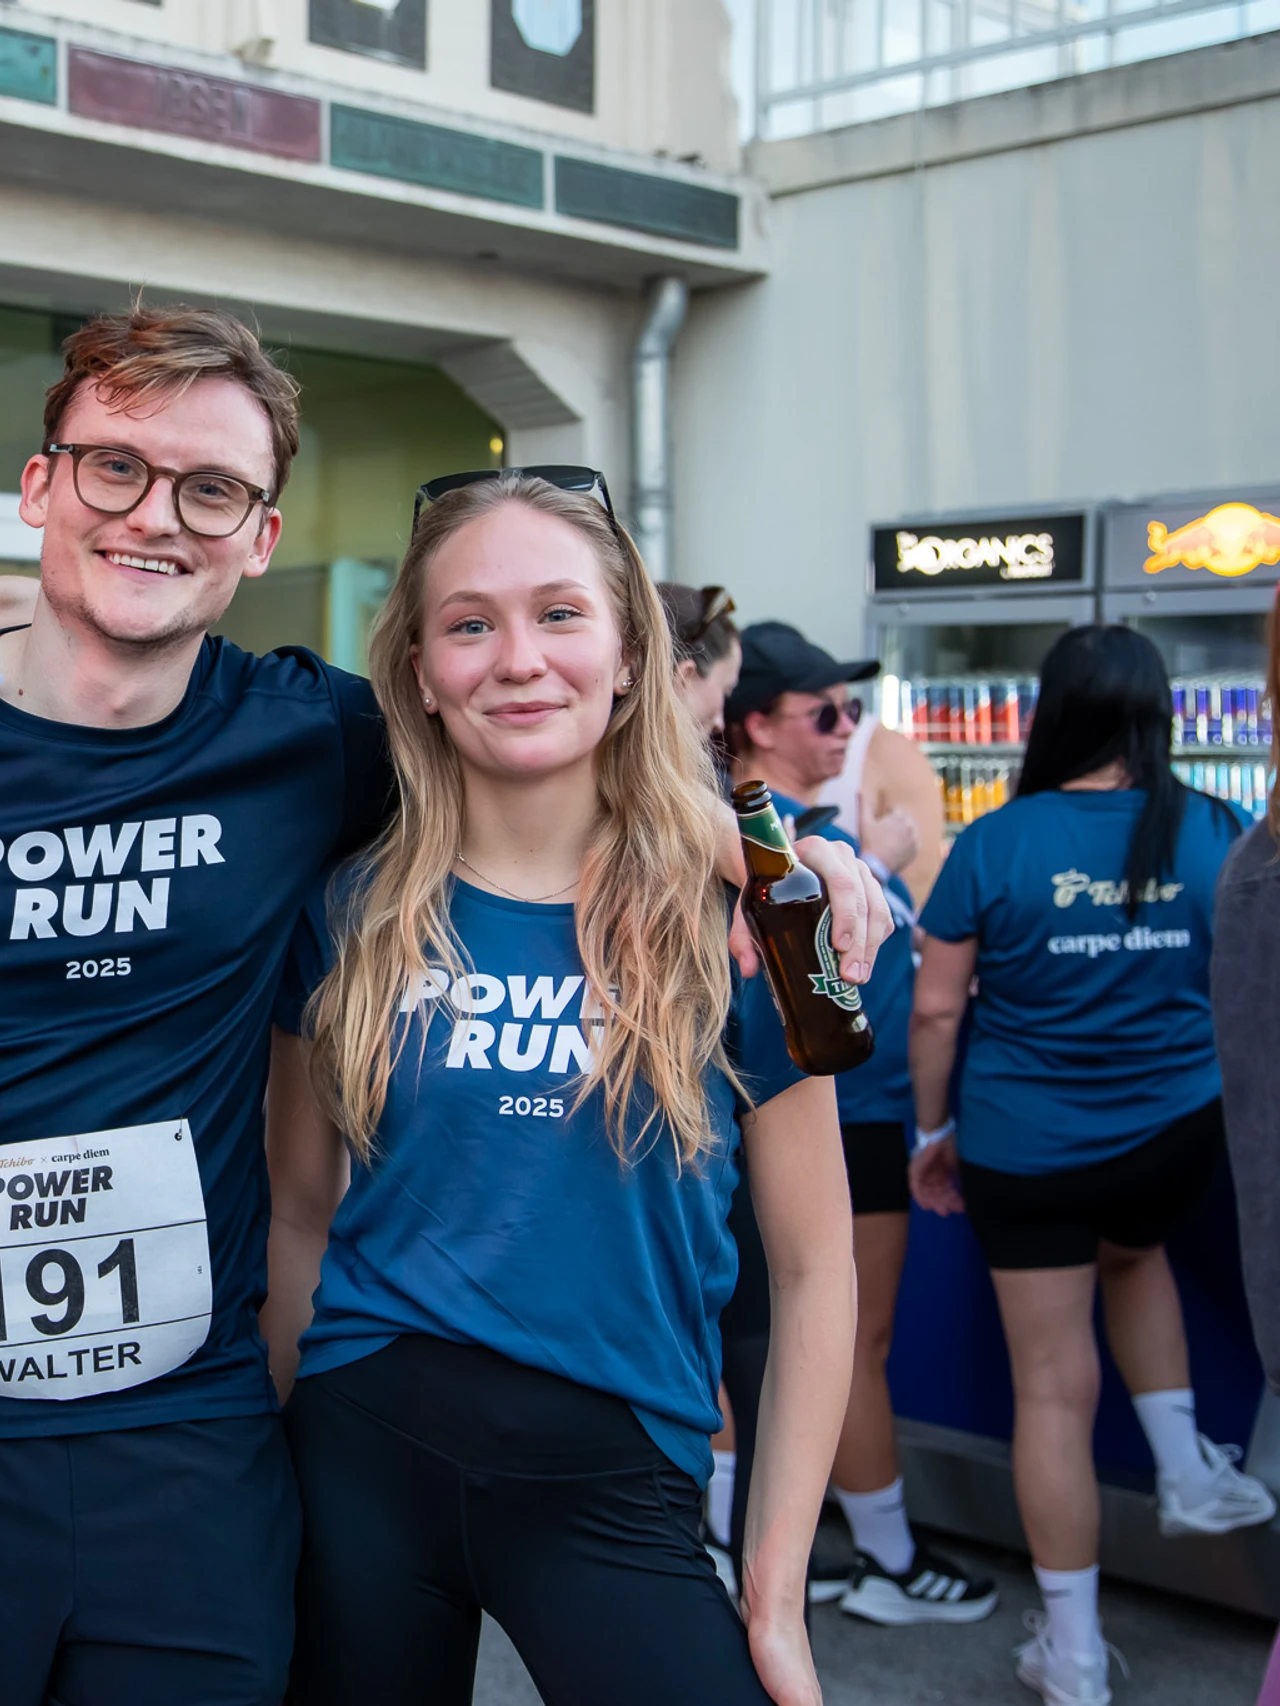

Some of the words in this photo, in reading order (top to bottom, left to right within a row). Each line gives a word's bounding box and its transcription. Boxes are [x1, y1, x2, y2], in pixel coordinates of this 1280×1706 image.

[9, 877, 171, 940] RUN
[1047, 933, 1120, 958] carpe
[1123, 926, 1191, 950] diem
[65, 957, 132, 980] 2025
[445, 1019, 605, 1075] RUN
[499, 1095, 565, 1118] 2025
[51, 1152, 81, 1164] carpe
[82, 1148, 110, 1159] diem
[10, 1197, 87, 1231] RUN
